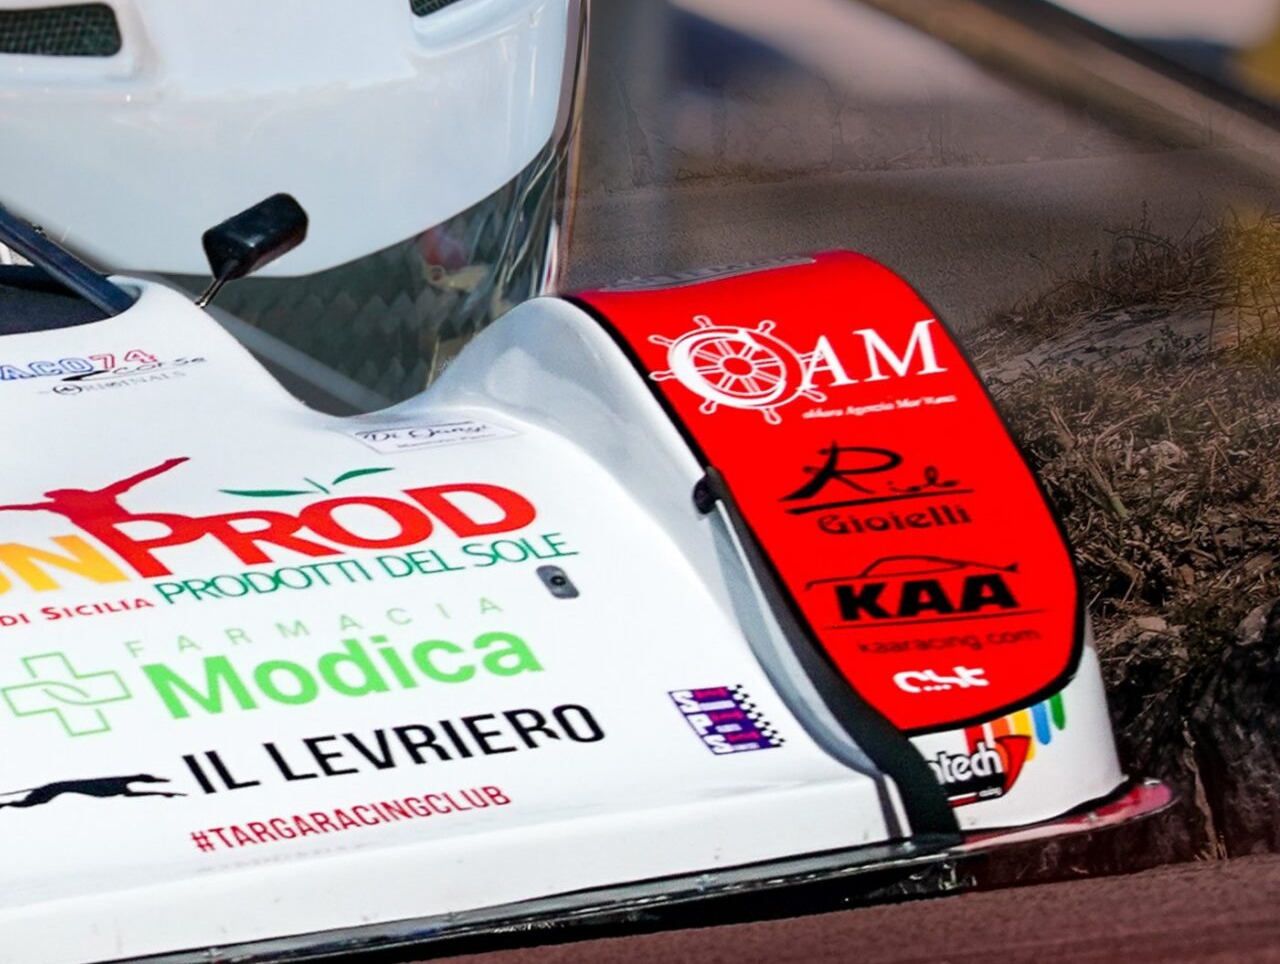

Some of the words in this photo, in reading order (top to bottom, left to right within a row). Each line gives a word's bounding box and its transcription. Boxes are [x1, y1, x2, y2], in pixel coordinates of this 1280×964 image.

[817, 504, 973, 535] Gioielli
[154, 558, 373, 605] PRODOTTI
[375, 551, 465, 579] DEL
[462, 531, 580, 569] SOLE
[835, 573, 1021, 621] KAA
[39, 596, 156, 622] SICILIA
[124, 596, 505, 658] FARMACIA
[142, 630, 546, 720] Modica
[182, 750, 260, 794] IL
[262, 704, 606, 782] LEVRIERO
[190, 785, 512, 853] #TARGARACINGCLUB
